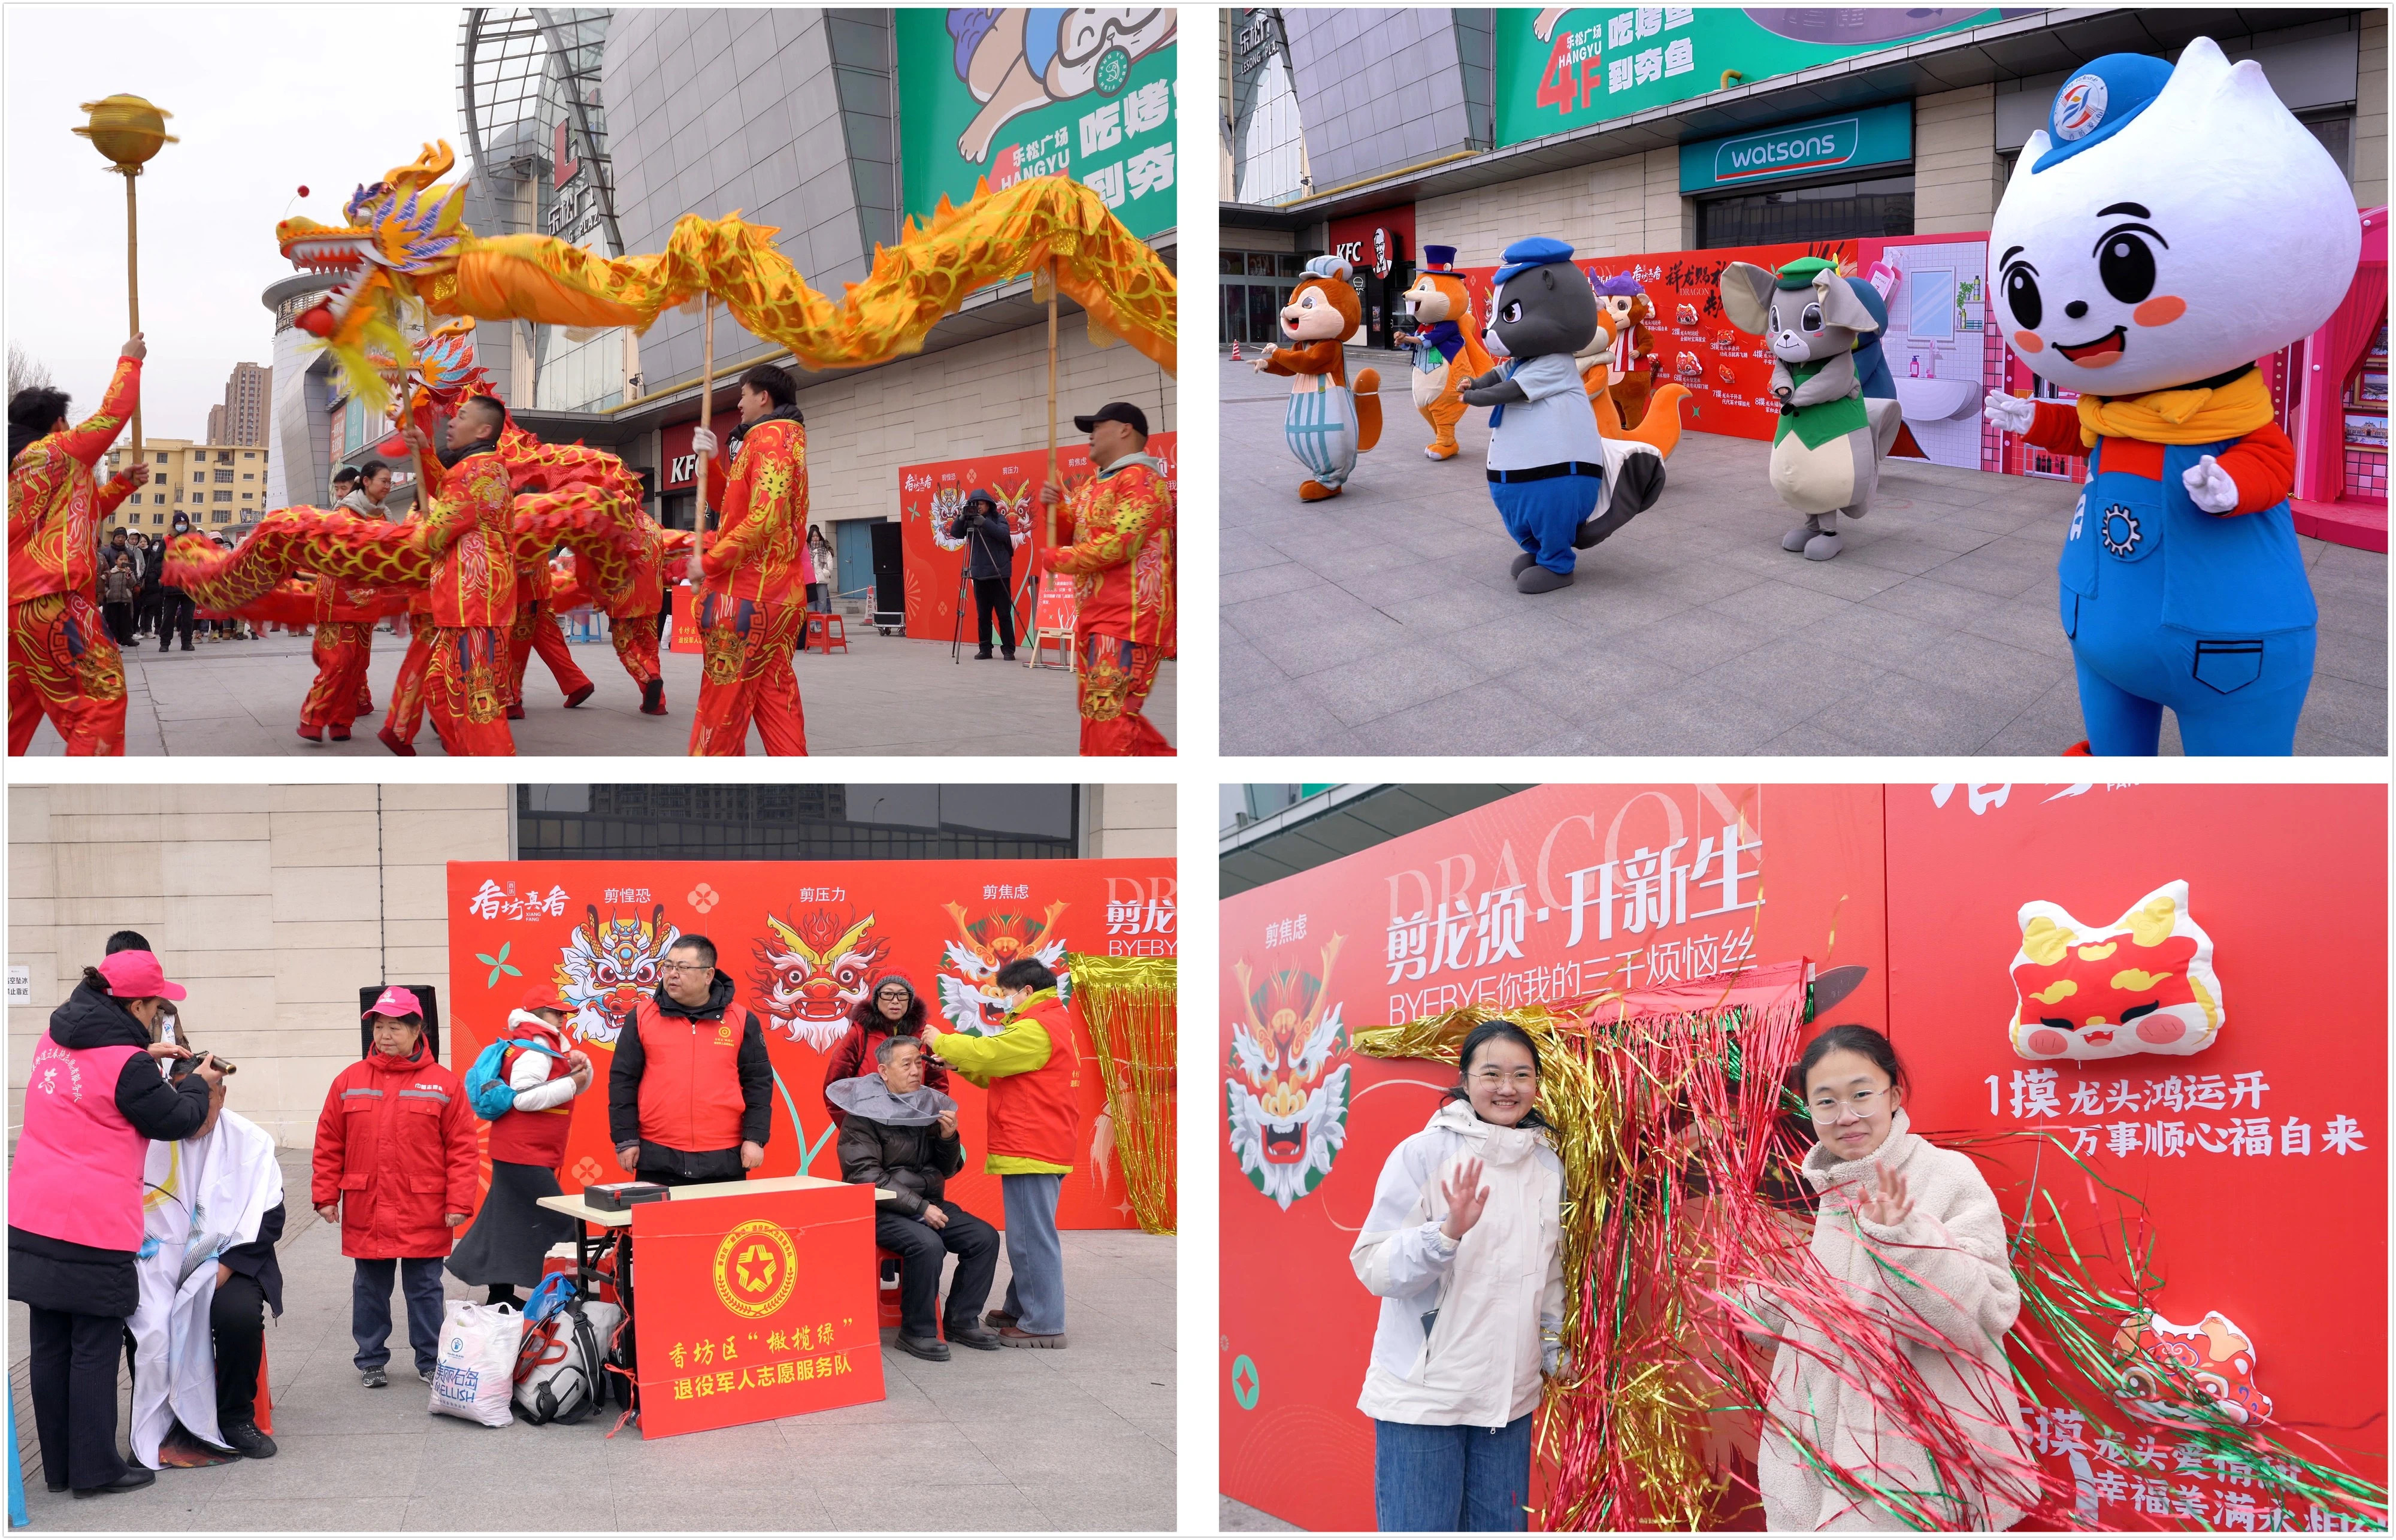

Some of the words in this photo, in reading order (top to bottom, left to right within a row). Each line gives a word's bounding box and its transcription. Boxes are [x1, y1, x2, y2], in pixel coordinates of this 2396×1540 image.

[1240, 14, 1270, 55] 乐松广
[1567, 24, 1601, 49] 乐松广场
[1241, 52, 1262, 74] LESONG
[1265, 40, 1279, 57] PLA
[1559, 41, 1602, 68] HANGYU
[1608, 37, 1694, 94] 到夯鱼
[1536, 31, 1601, 115] 4F
[1079, 78, 1177, 159] 吃烤
[1013, 126, 1069, 168] 乐松广场
[1732, 134, 1835, 168] watsons
[1001, 148, 1070, 191] HANGYU
[548, 183, 595, 236] 乐松广
[1336, 241, 1362, 262] KFC
[1680, 288, 1709, 296] DRAGON
[1002, 465, 1019, 475] 剪压力
[1068, 457, 1087, 467] 剪焦虑
[604, 888, 651, 903] 剪惶恐
[800, 887, 846, 903] 剪压力
[982, 884, 1029, 900] 剪焦虑
[1106, 899, 1175, 935] 剪龙
[1265, 913, 1308, 949] 剪焦虑
[1984, 1069, 2061, 1119] 1摸
[2068, 1071, 2271, 1116] 龙头鸿运开
[2068, 1115, 2369, 1158] 万事顺心福自来
[673, 1354, 853, 1400] 退役军人志愿服务队
